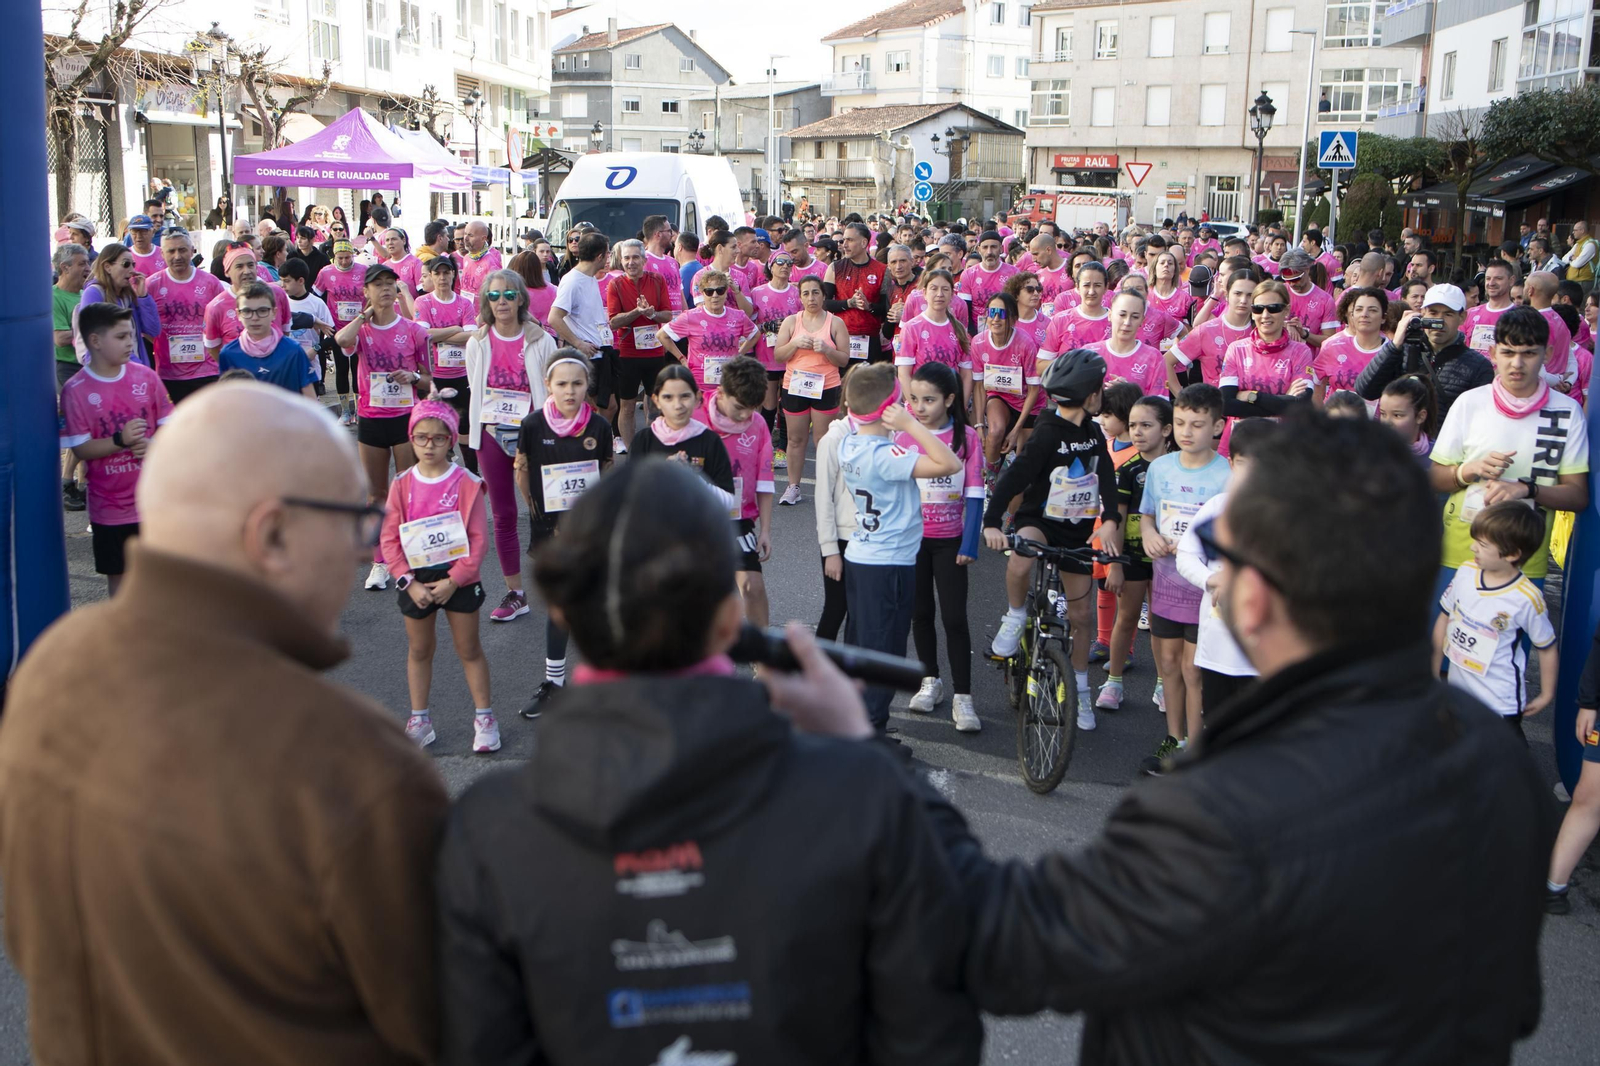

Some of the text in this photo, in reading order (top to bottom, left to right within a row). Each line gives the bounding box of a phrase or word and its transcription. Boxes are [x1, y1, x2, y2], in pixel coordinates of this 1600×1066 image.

[1085, 155, 1111, 167] RAÚL
[256, 167, 390, 181] CONCELLERÍA DE IGUALDADE
[803, 380, 814, 388] 45
[996, 375, 1012, 384] 252
[386, 384, 400, 393] 19
[501, 402, 514, 412] 21
[564, 478, 586, 490] 173
[1071, 491, 1092, 502] 170
[428, 531, 446, 545] 20
[1452, 627, 1477, 648] 359
